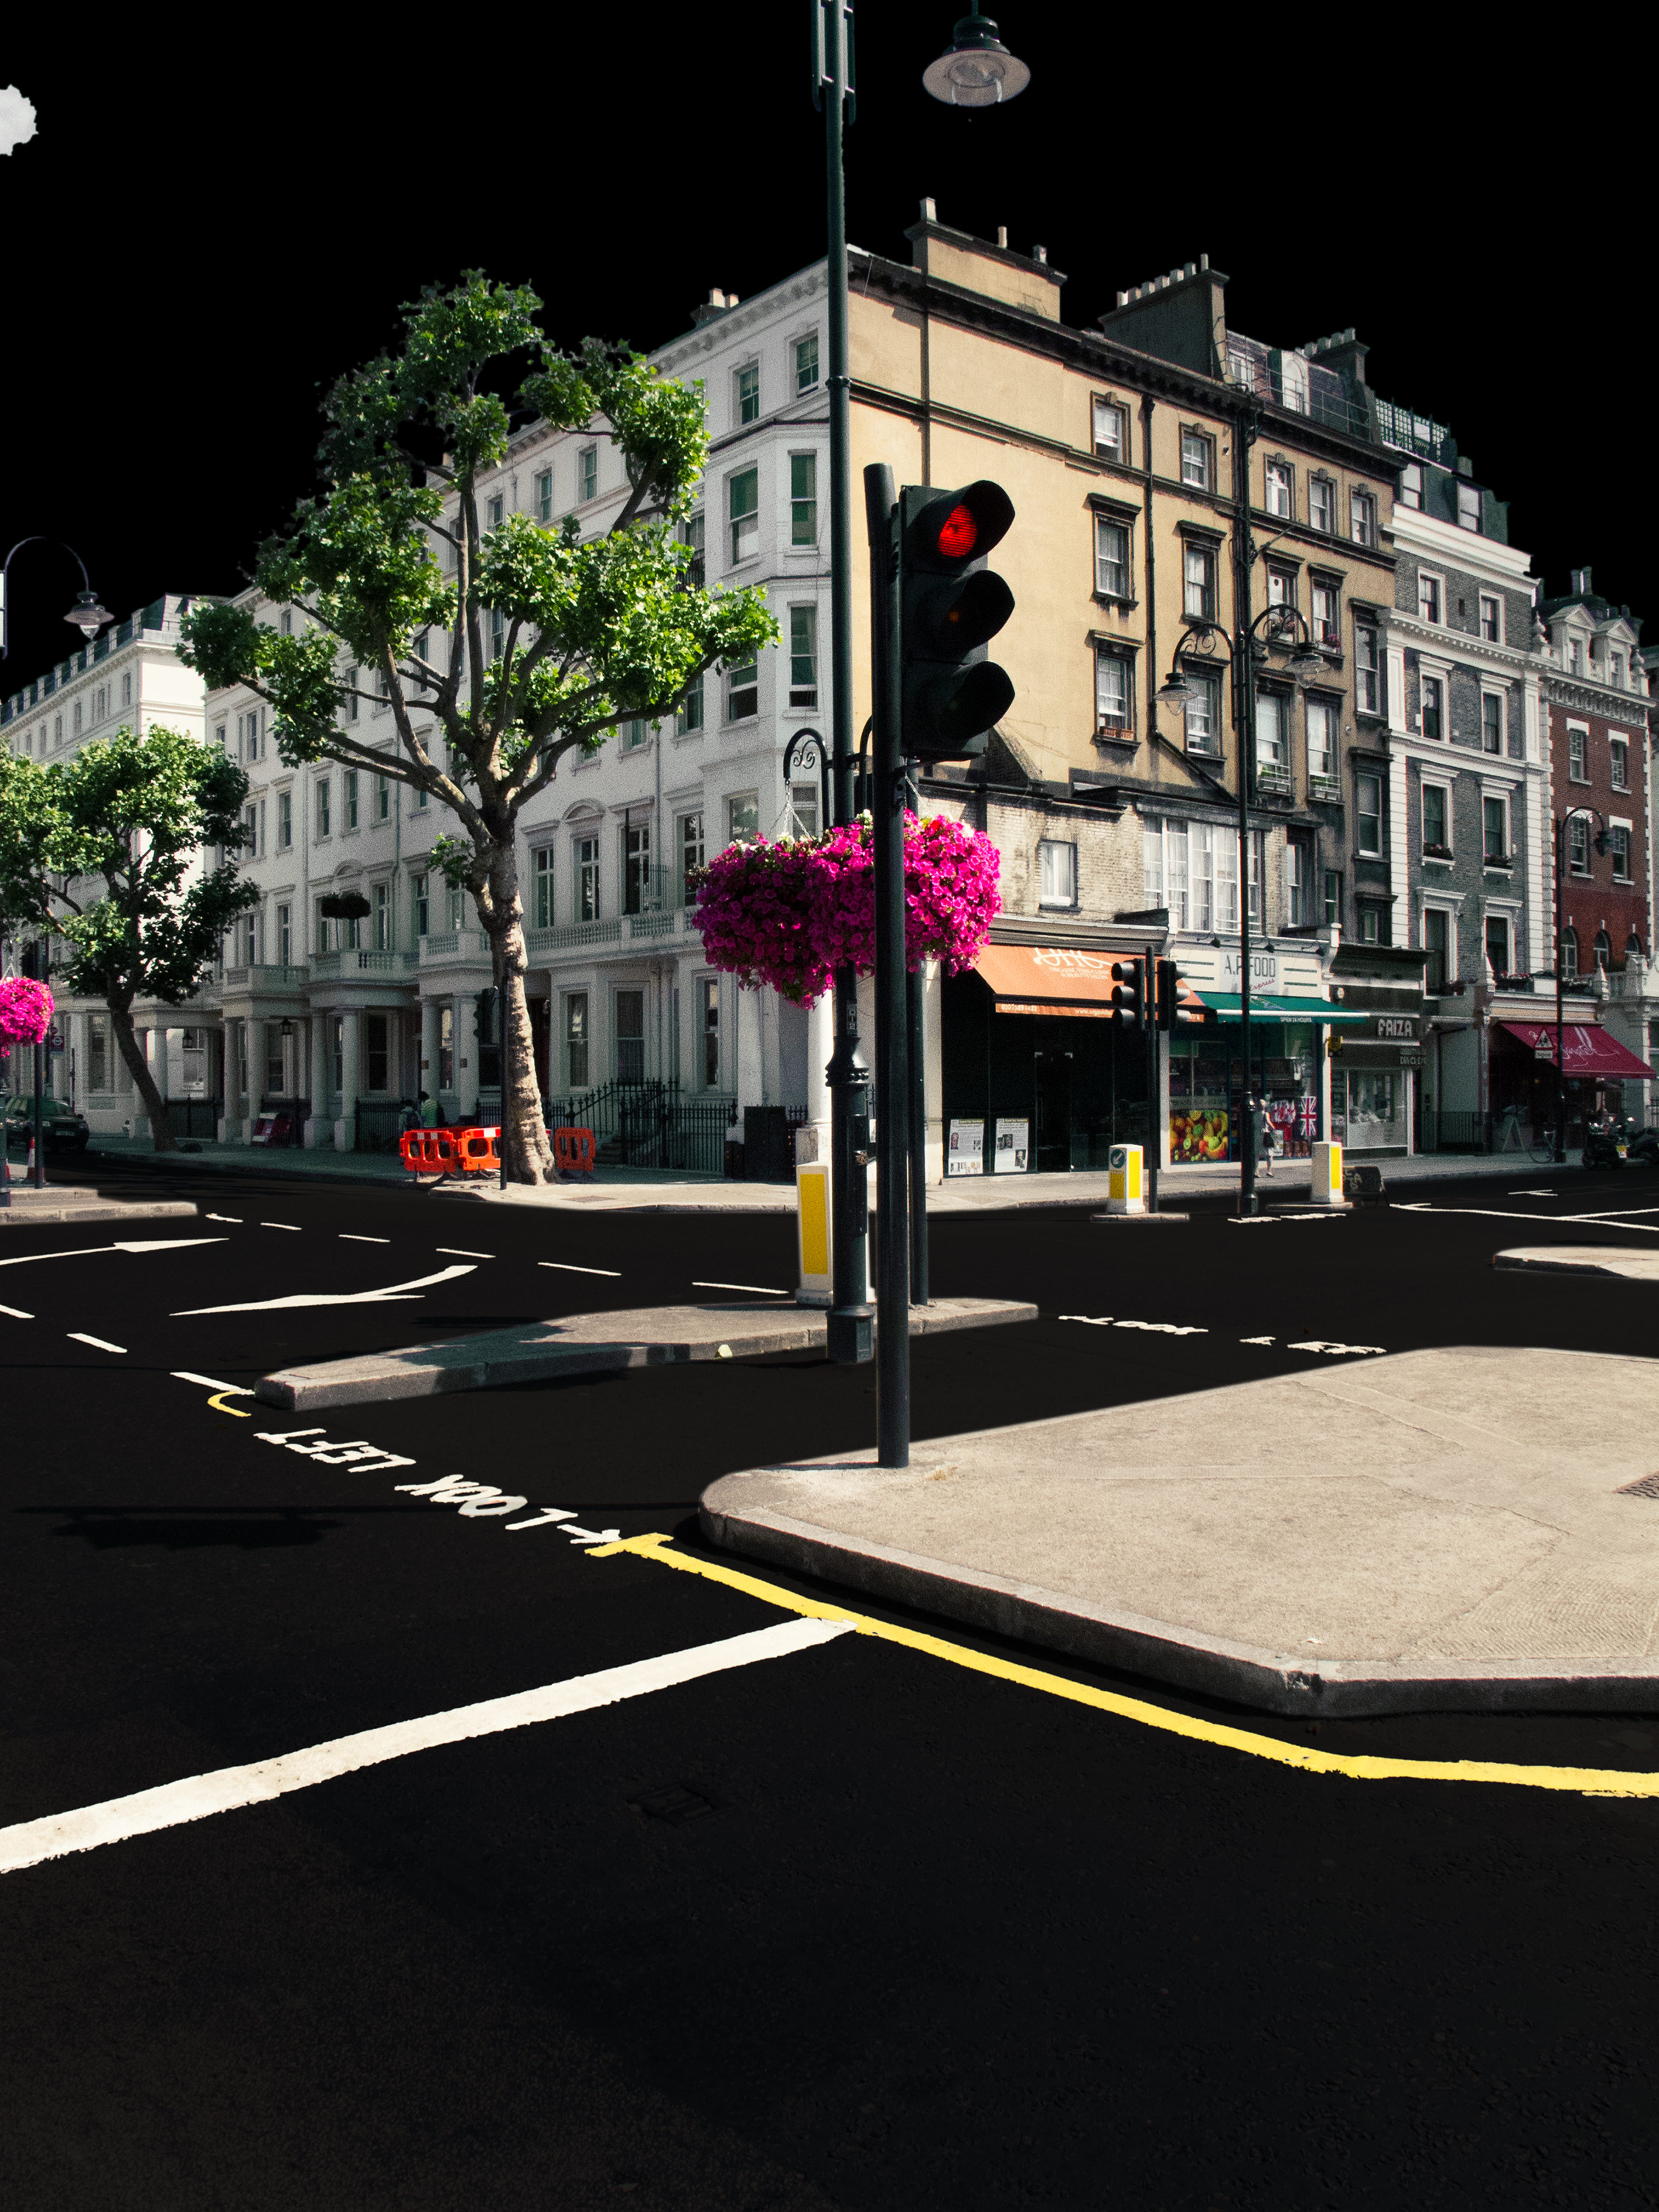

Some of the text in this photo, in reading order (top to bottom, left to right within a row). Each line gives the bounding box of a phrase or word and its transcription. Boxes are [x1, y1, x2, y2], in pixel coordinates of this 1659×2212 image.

[1377, 1019, 1413, 1037] FAIZA
[253, 1427, 579, 1531] LOOK LEFT
